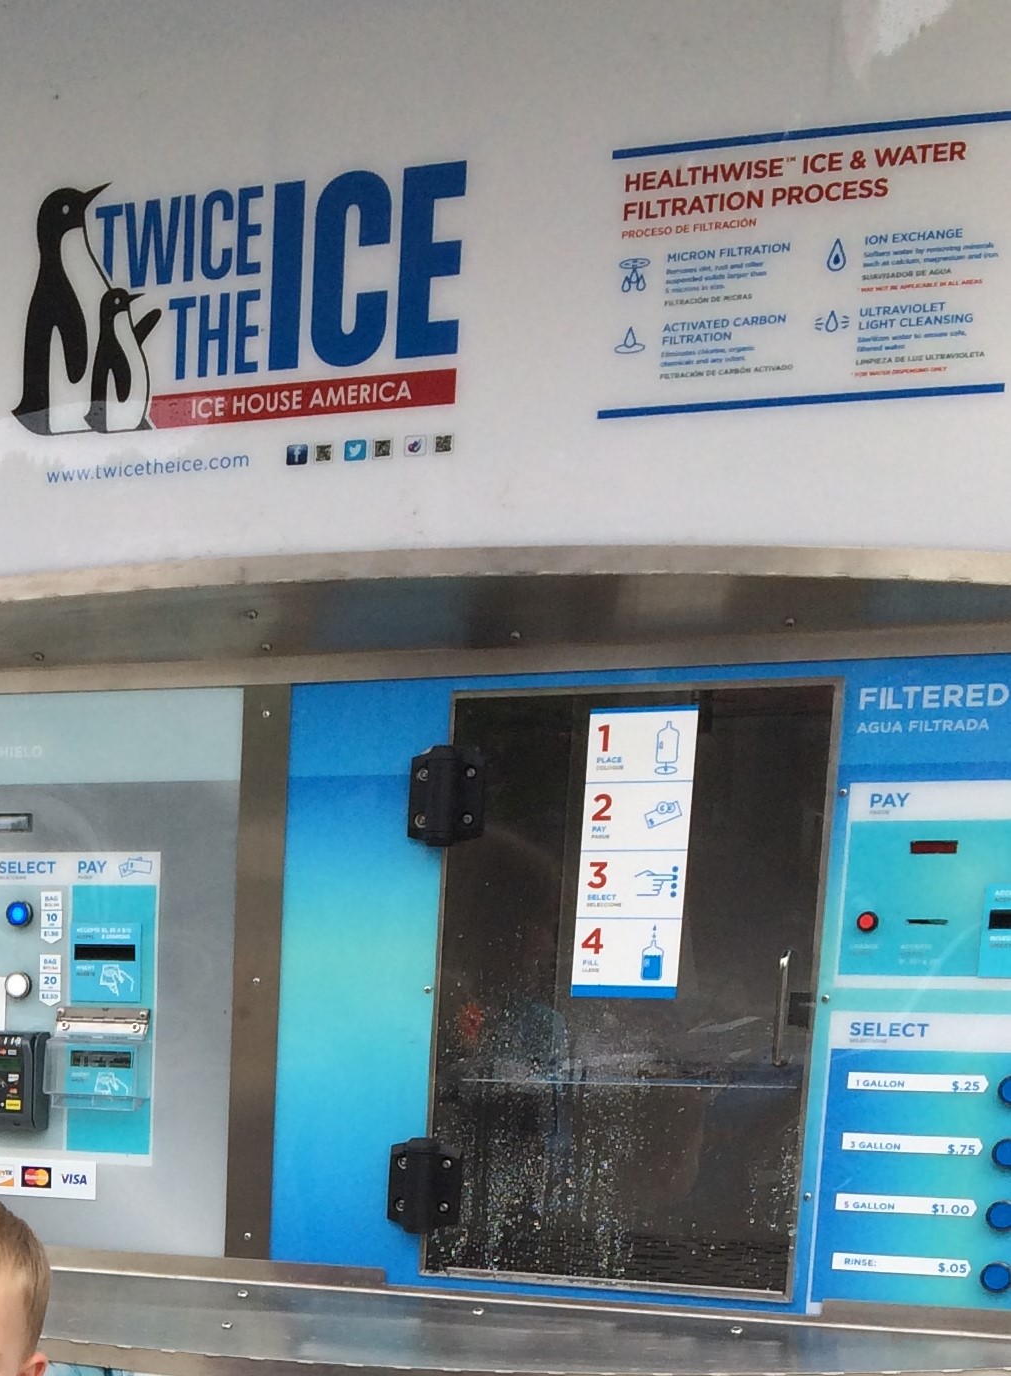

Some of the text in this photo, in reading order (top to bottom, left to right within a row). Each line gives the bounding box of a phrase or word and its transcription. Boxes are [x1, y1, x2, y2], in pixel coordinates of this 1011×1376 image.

[802, 150, 843, 175] ICE
[850, 149, 866, 169] &
[874, 141, 967, 166] WATER
[623, 178, 889, 221] FILTRATION PROCESS
[621, 218, 757, 239] PROCESO DE FILTRACIÓN
[865, 228, 963, 245] ION EXCHANGE
[95, 185, 263, 289] TWICE
[667, 242, 790, 263] MICRON FILTRATION
[268, 159, 467, 372] ICE
[929, 268, 952, 276] AGUA
[860, 302, 945, 317] ULTRAVIOLET
[663, 314, 787, 333] ACTIVATED CARBON
[859, 313, 973, 331] LIGHT CLEANSING
[168, 289, 261, 380] THE
[662, 332, 732, 346] FILTRATION
[925, 352, 985, 361] ULTRAVIOLETA
[754, 364, 793, 373] ACTIVADO
[191, 380, 412, 420] ICE HOUSE AMERICA
[46, 454, 249, 483] www.twicetheice.com
[859, 683, 1009, 710] FILTERED
[856, 718, 989, 734] AGUA FILTRADA
[598, 724, 610, 752] 1
[0, 745, 42, 759] HIELO
[597, 756, 622, 764] PLACE
[591, 794, 612, 821] 2
[870, 793, 910, 808] PAY
[77, 860, 107, 874] PAY
[587, 862, 608, 889] 3
[47, 913, 58, 922] 10
[581, 928, 604, 955] 4
[44, 976, 57, 985] 20
[850, 1022, 929, 1037] SELECT
[856, 1079, 980, 1092] 1 GALLON $.25
[859, 1142, 901, 1150] GALLON
[947, 1144, 976, 1155] $.75
[61, 1174, 87, 1185] VISA
[853, 1202, 895, 1210] GALLON
[844, 1258, 967, 1274] RINSE: $.05
